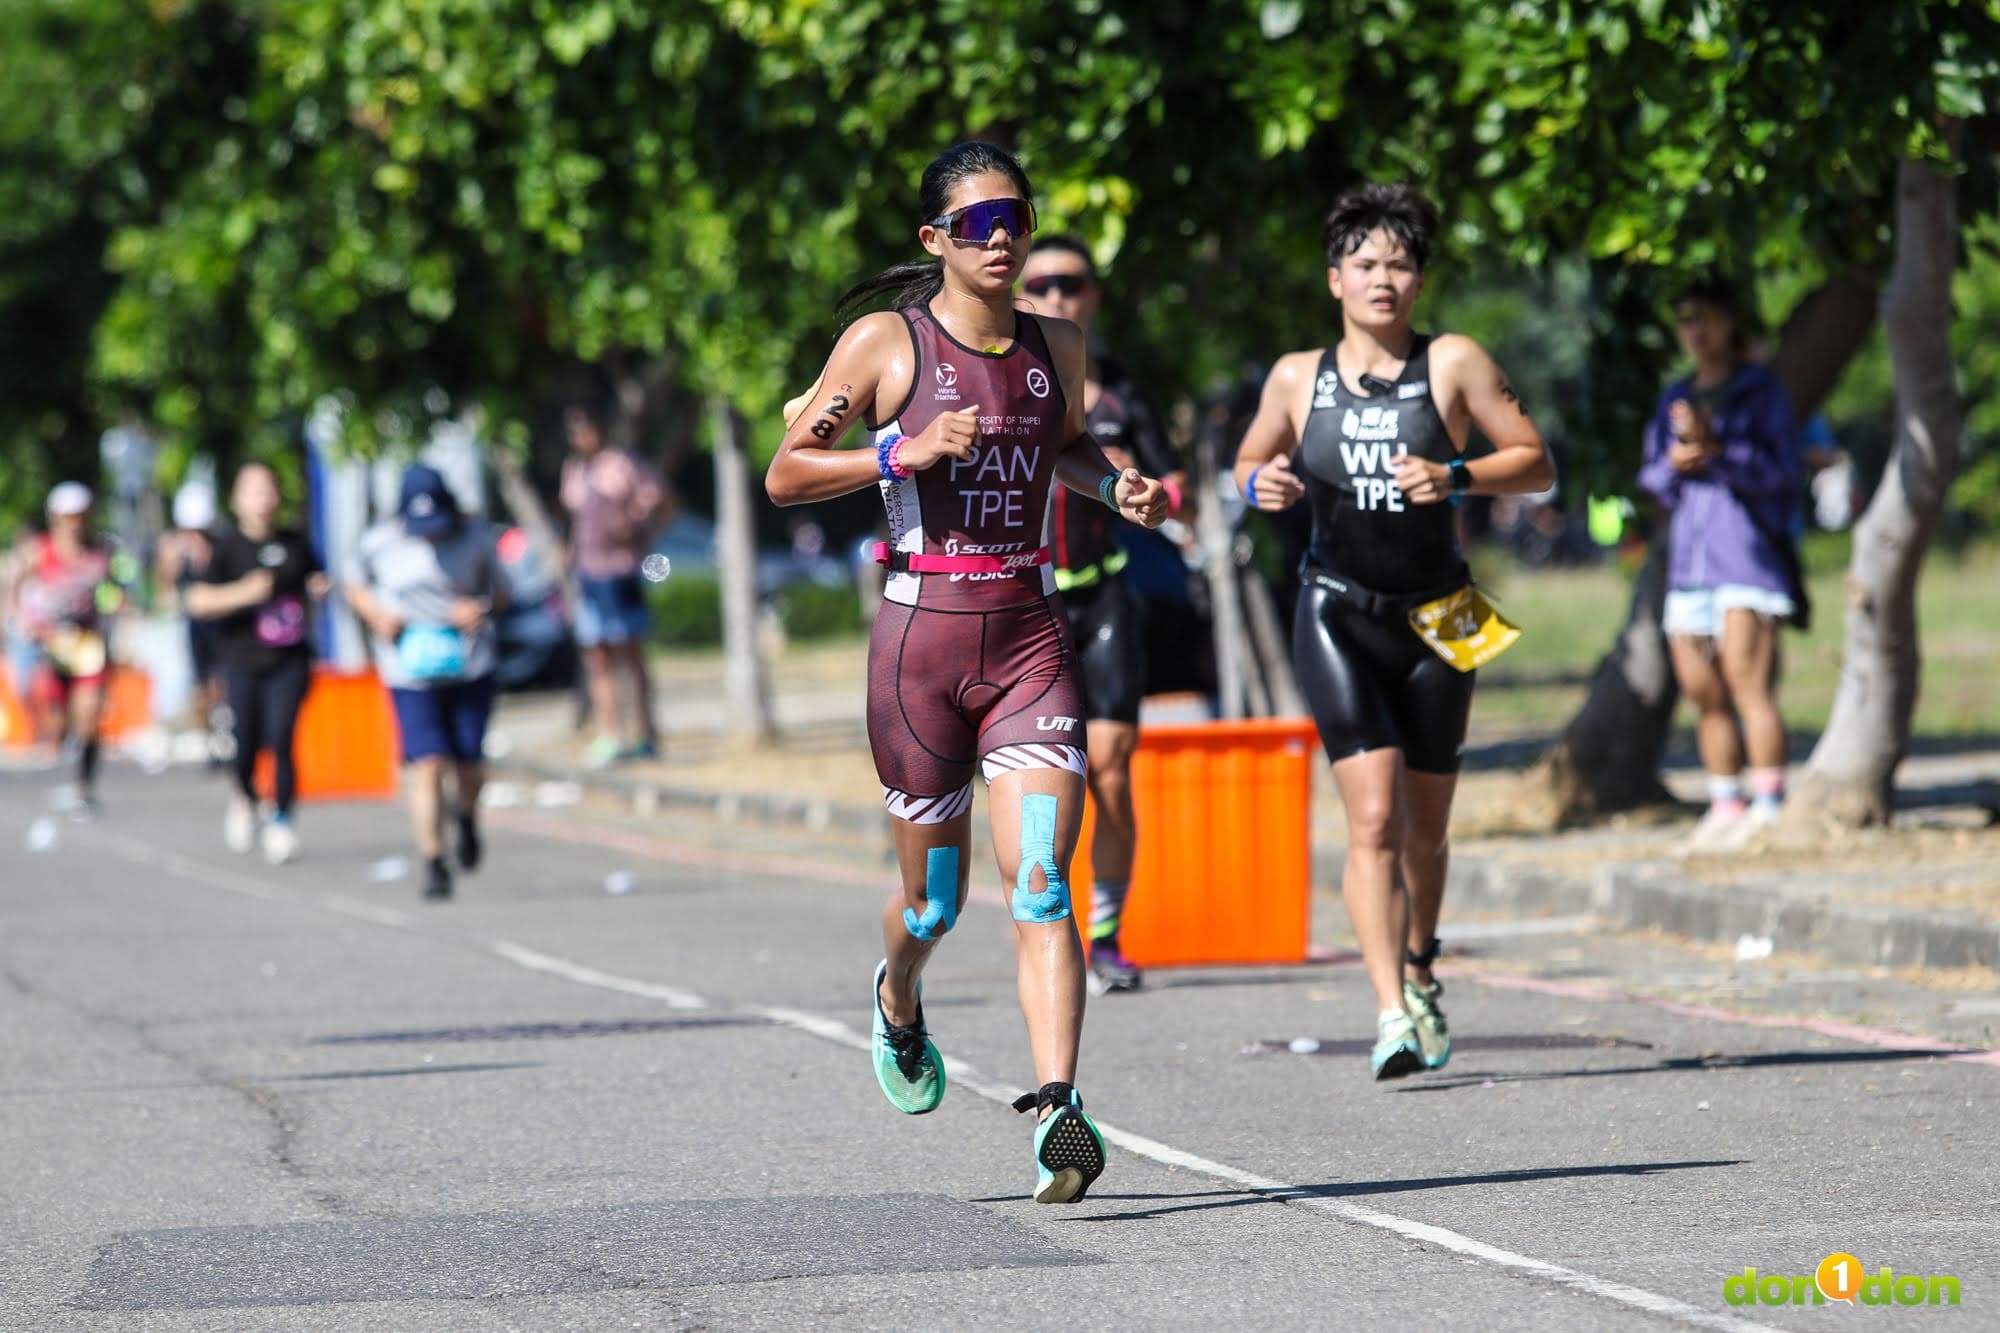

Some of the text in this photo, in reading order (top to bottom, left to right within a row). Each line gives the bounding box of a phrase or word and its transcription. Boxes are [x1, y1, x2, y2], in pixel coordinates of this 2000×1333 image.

[982, 426, 1030, 435] IATHLON
[1006, 416, 1016, 425] OF
[1018, 416, 1041, 425] TAIPEI
[949, 445, 1041, 482] PAN
[1339, 442, 1408, 475] WU
[891, 485, 905, 529] IVERSITY
[958, 490, 1024, 528] TPE
[1352, 477, 1405, 512] TPE
[960, 541, 1026, 554] SCOTT
